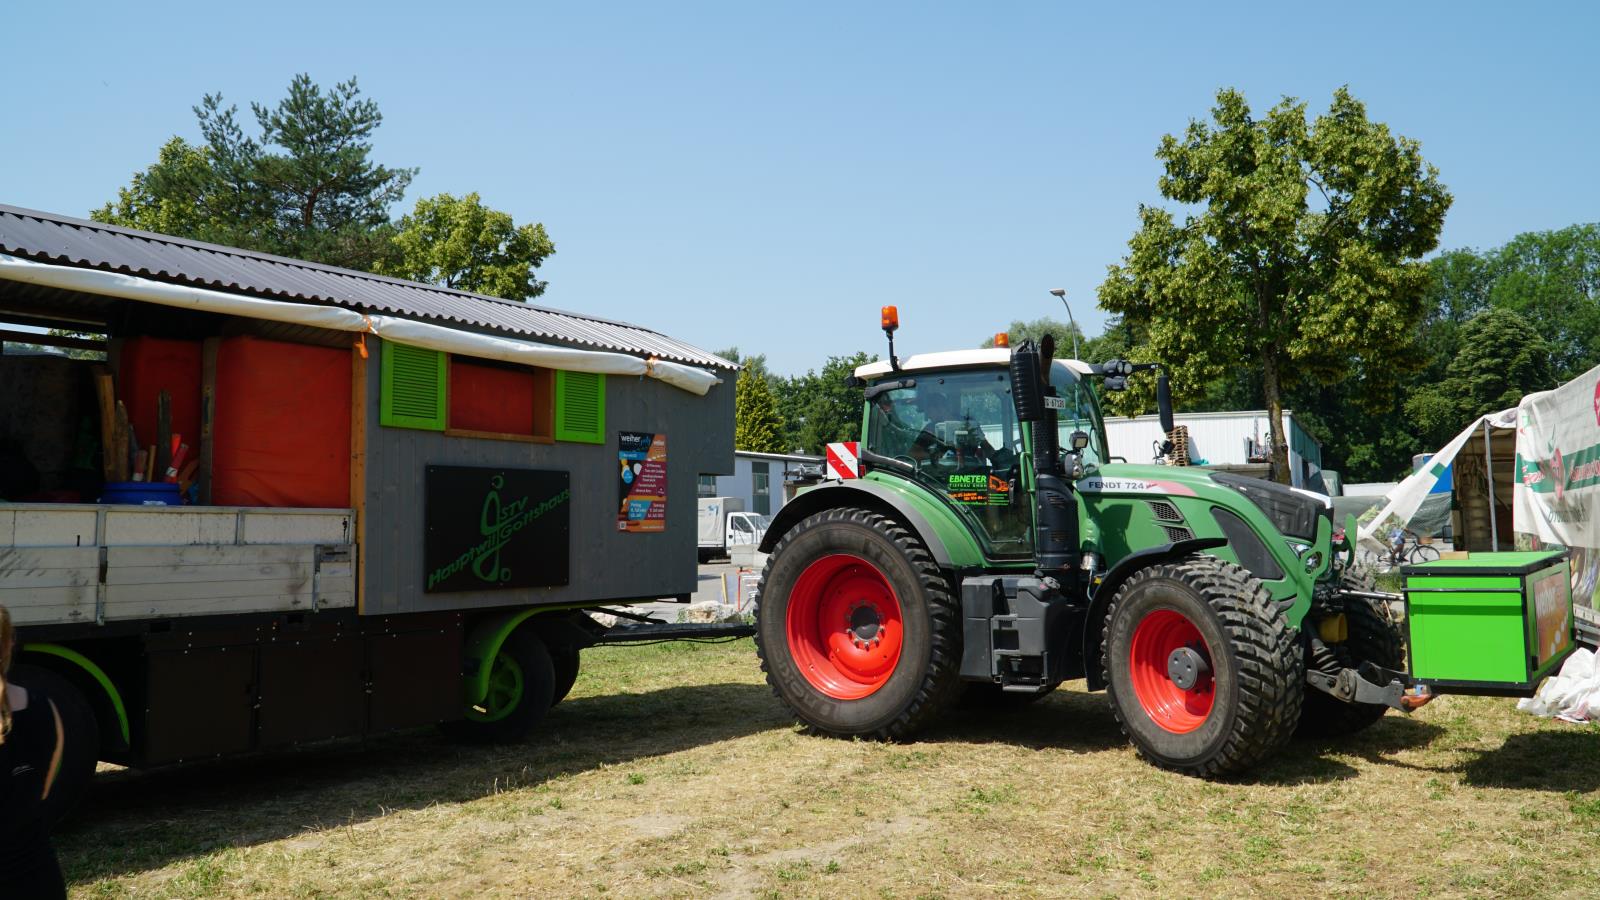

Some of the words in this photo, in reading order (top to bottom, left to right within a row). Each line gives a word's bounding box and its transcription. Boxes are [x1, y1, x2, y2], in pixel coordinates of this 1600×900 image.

[949, 474, 987, 483] EBNETER
[1088, 481, 1121, 489] FENDT
[1125, 482, 1144, 490] 724
[501, 496, 529, 519] STV
